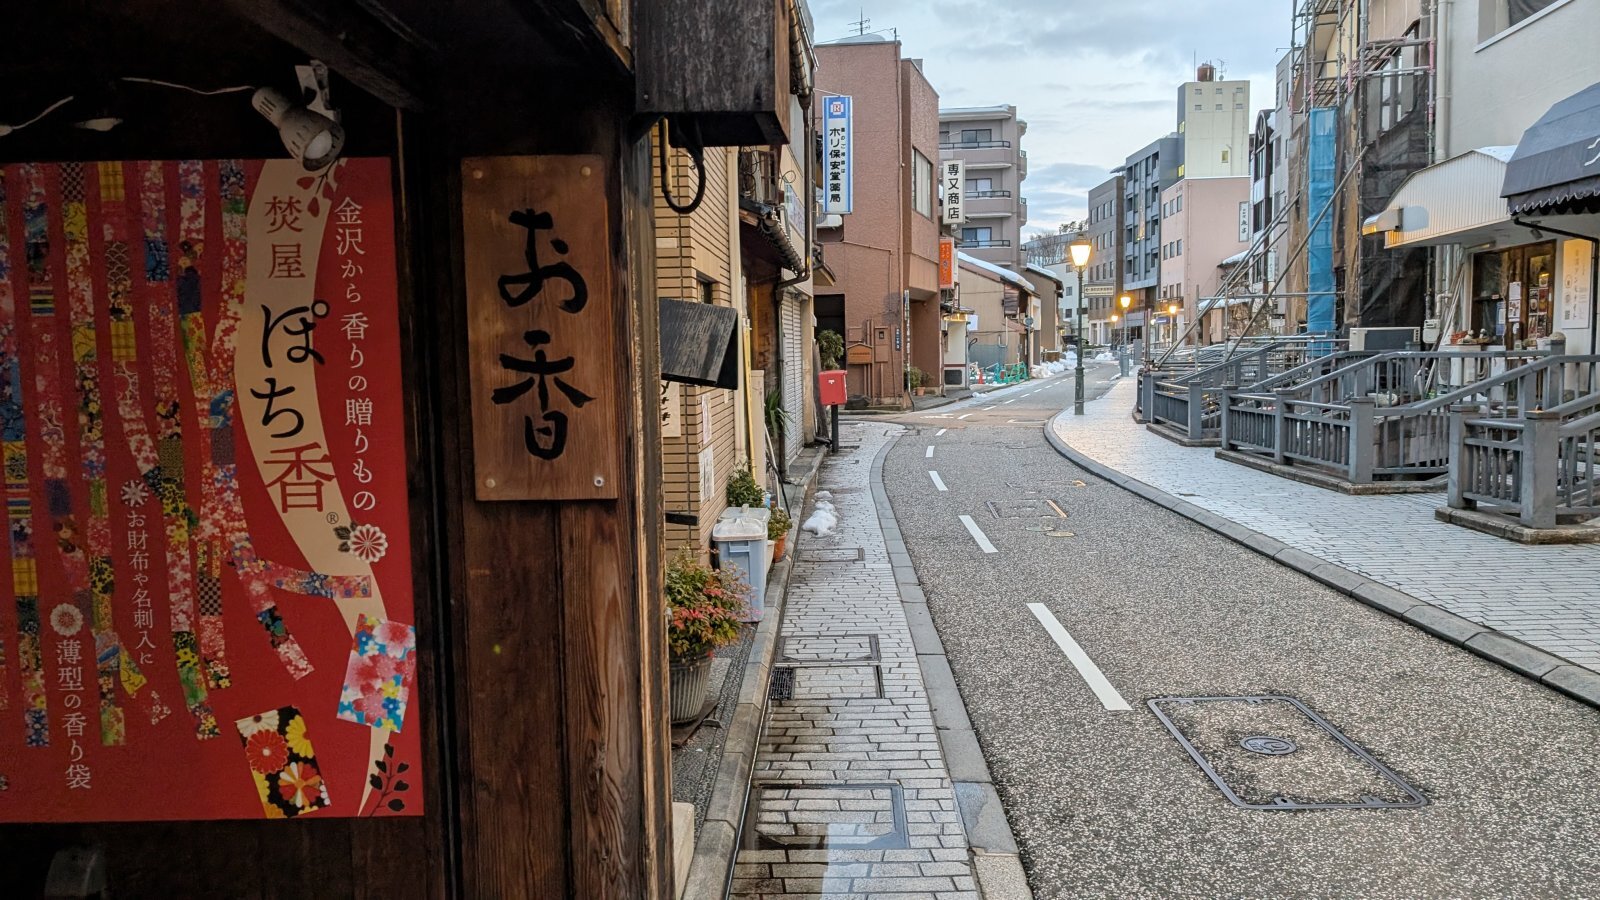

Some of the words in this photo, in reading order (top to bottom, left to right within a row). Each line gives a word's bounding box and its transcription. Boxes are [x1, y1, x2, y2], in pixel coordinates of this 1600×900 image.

[264, 196, 306, 279] 焚屋
[829, 127, 841, 203] ホリ保安堂薬局
[947, 163, 960, 220] 専又商店
[250, 300, 336, 513] ぽち香
[334, 196, 376, 511] 金沢から香りの贈りもの
[491, 208, 597, 461] お香
[127, 510, 155, 665] お財布や名刺入に
[55, 640, 92, 789] 薄型の香り袋
